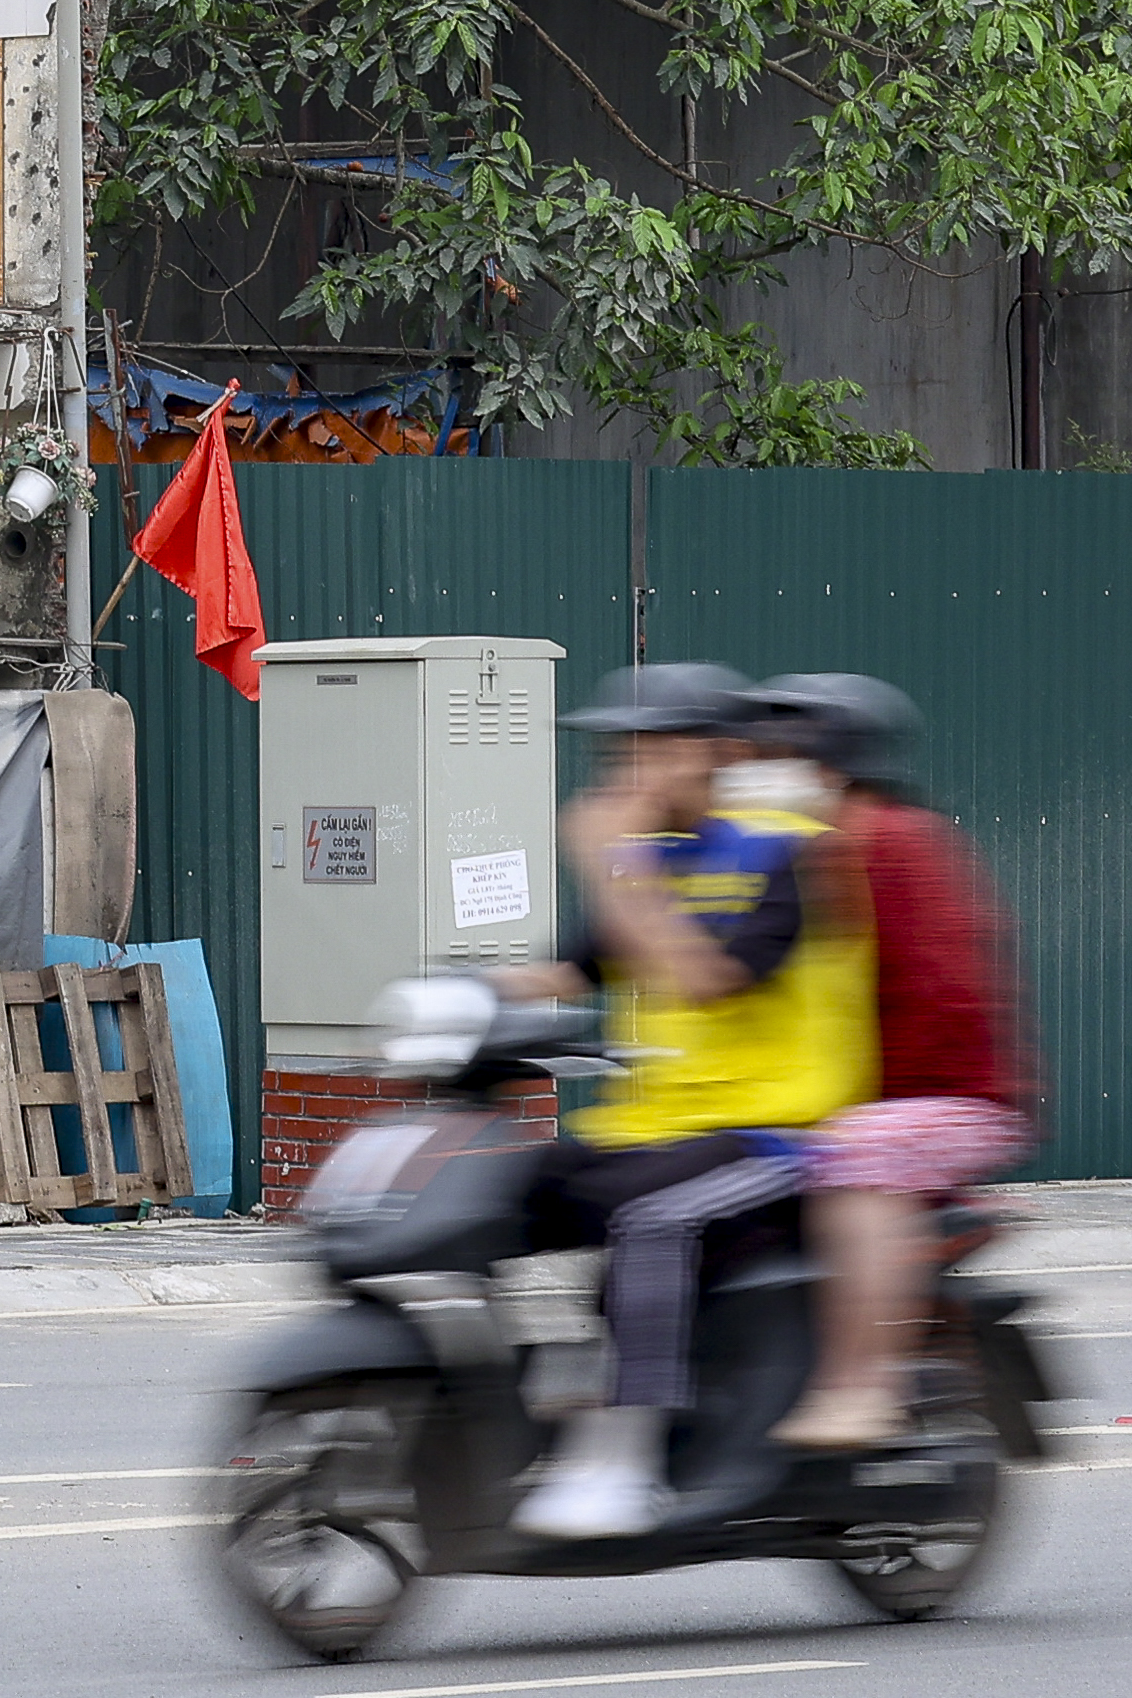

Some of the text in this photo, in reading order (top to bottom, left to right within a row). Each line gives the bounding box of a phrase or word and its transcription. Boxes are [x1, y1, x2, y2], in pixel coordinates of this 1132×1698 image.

[322, 814, 337, 830] CẤM
[340, 819, 350, 833] LẠI
[329, 852, 346, 860] NGUY
